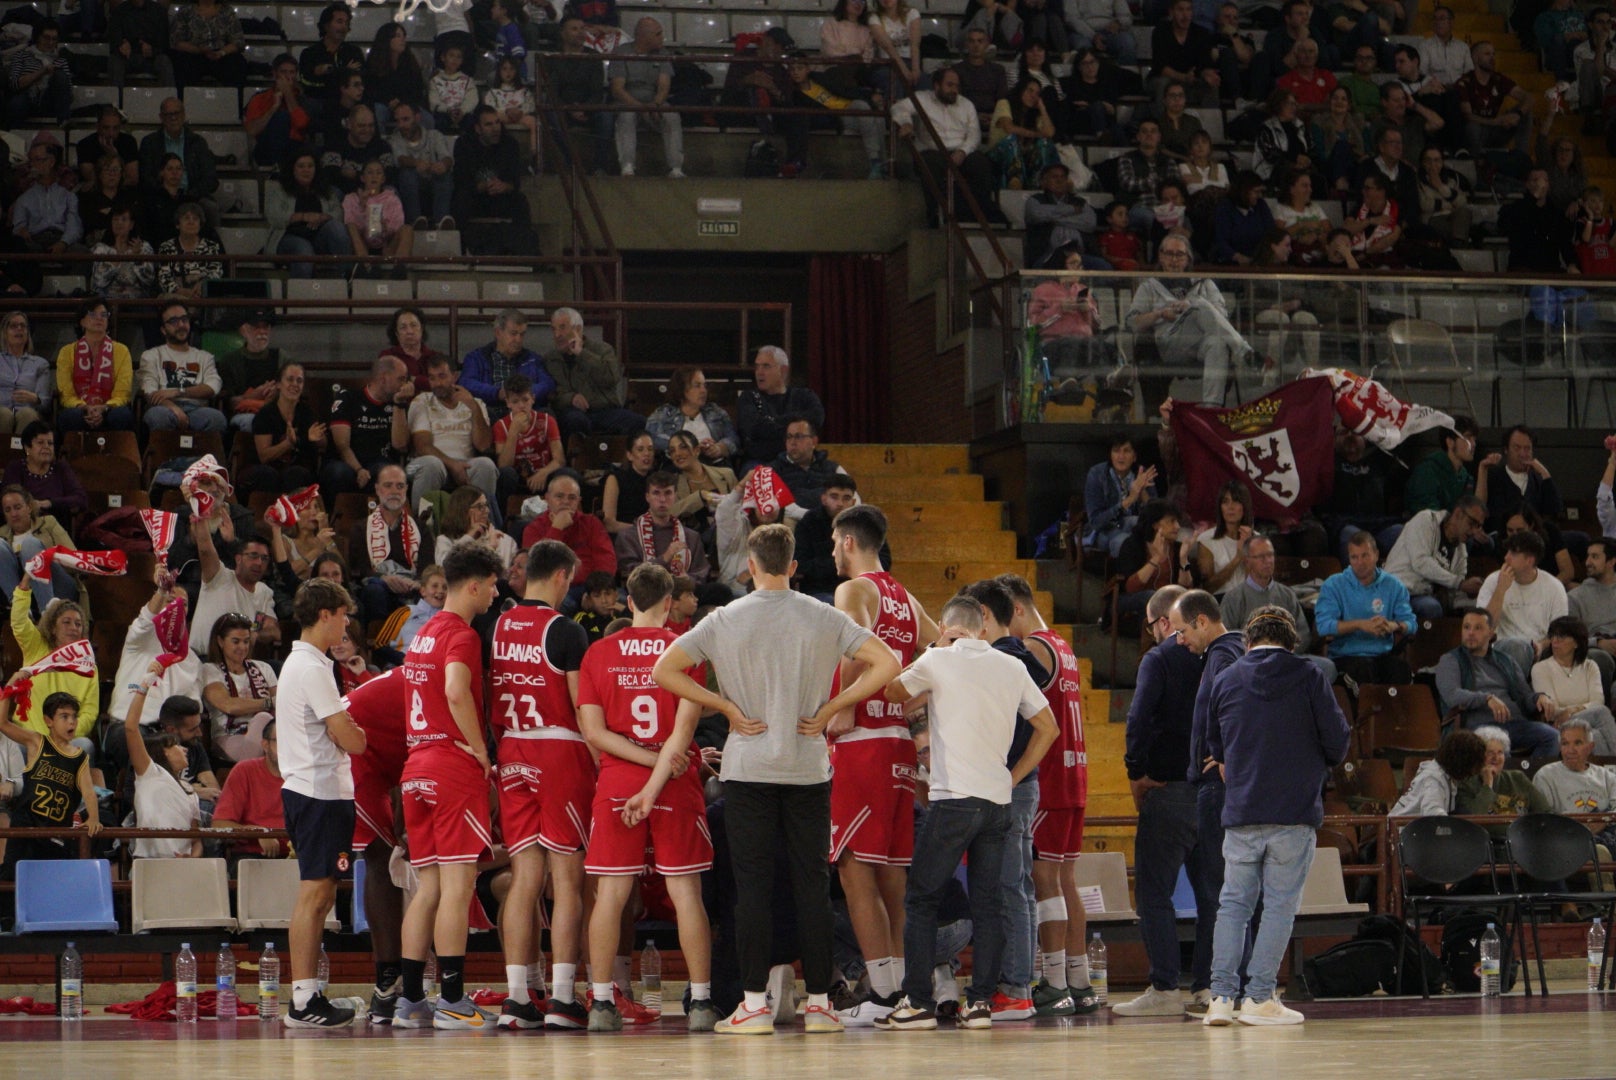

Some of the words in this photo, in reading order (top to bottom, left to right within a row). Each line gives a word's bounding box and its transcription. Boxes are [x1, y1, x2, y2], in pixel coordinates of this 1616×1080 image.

[883, 449, 896, 464] 8
[913, 507, 923, 522] 7
[493, 641, 541, 664] LLANAS
[618, 638, 666, 656] YAGO
[617, 675, 638, 686] BECA
[410, 688, 429, 731] 8
[500, 692, 544, 733] 33
[631, 695, 659, 738] 9
[1068, 700, 1083, 742] 11
[31, 783, 71, 822] 23
